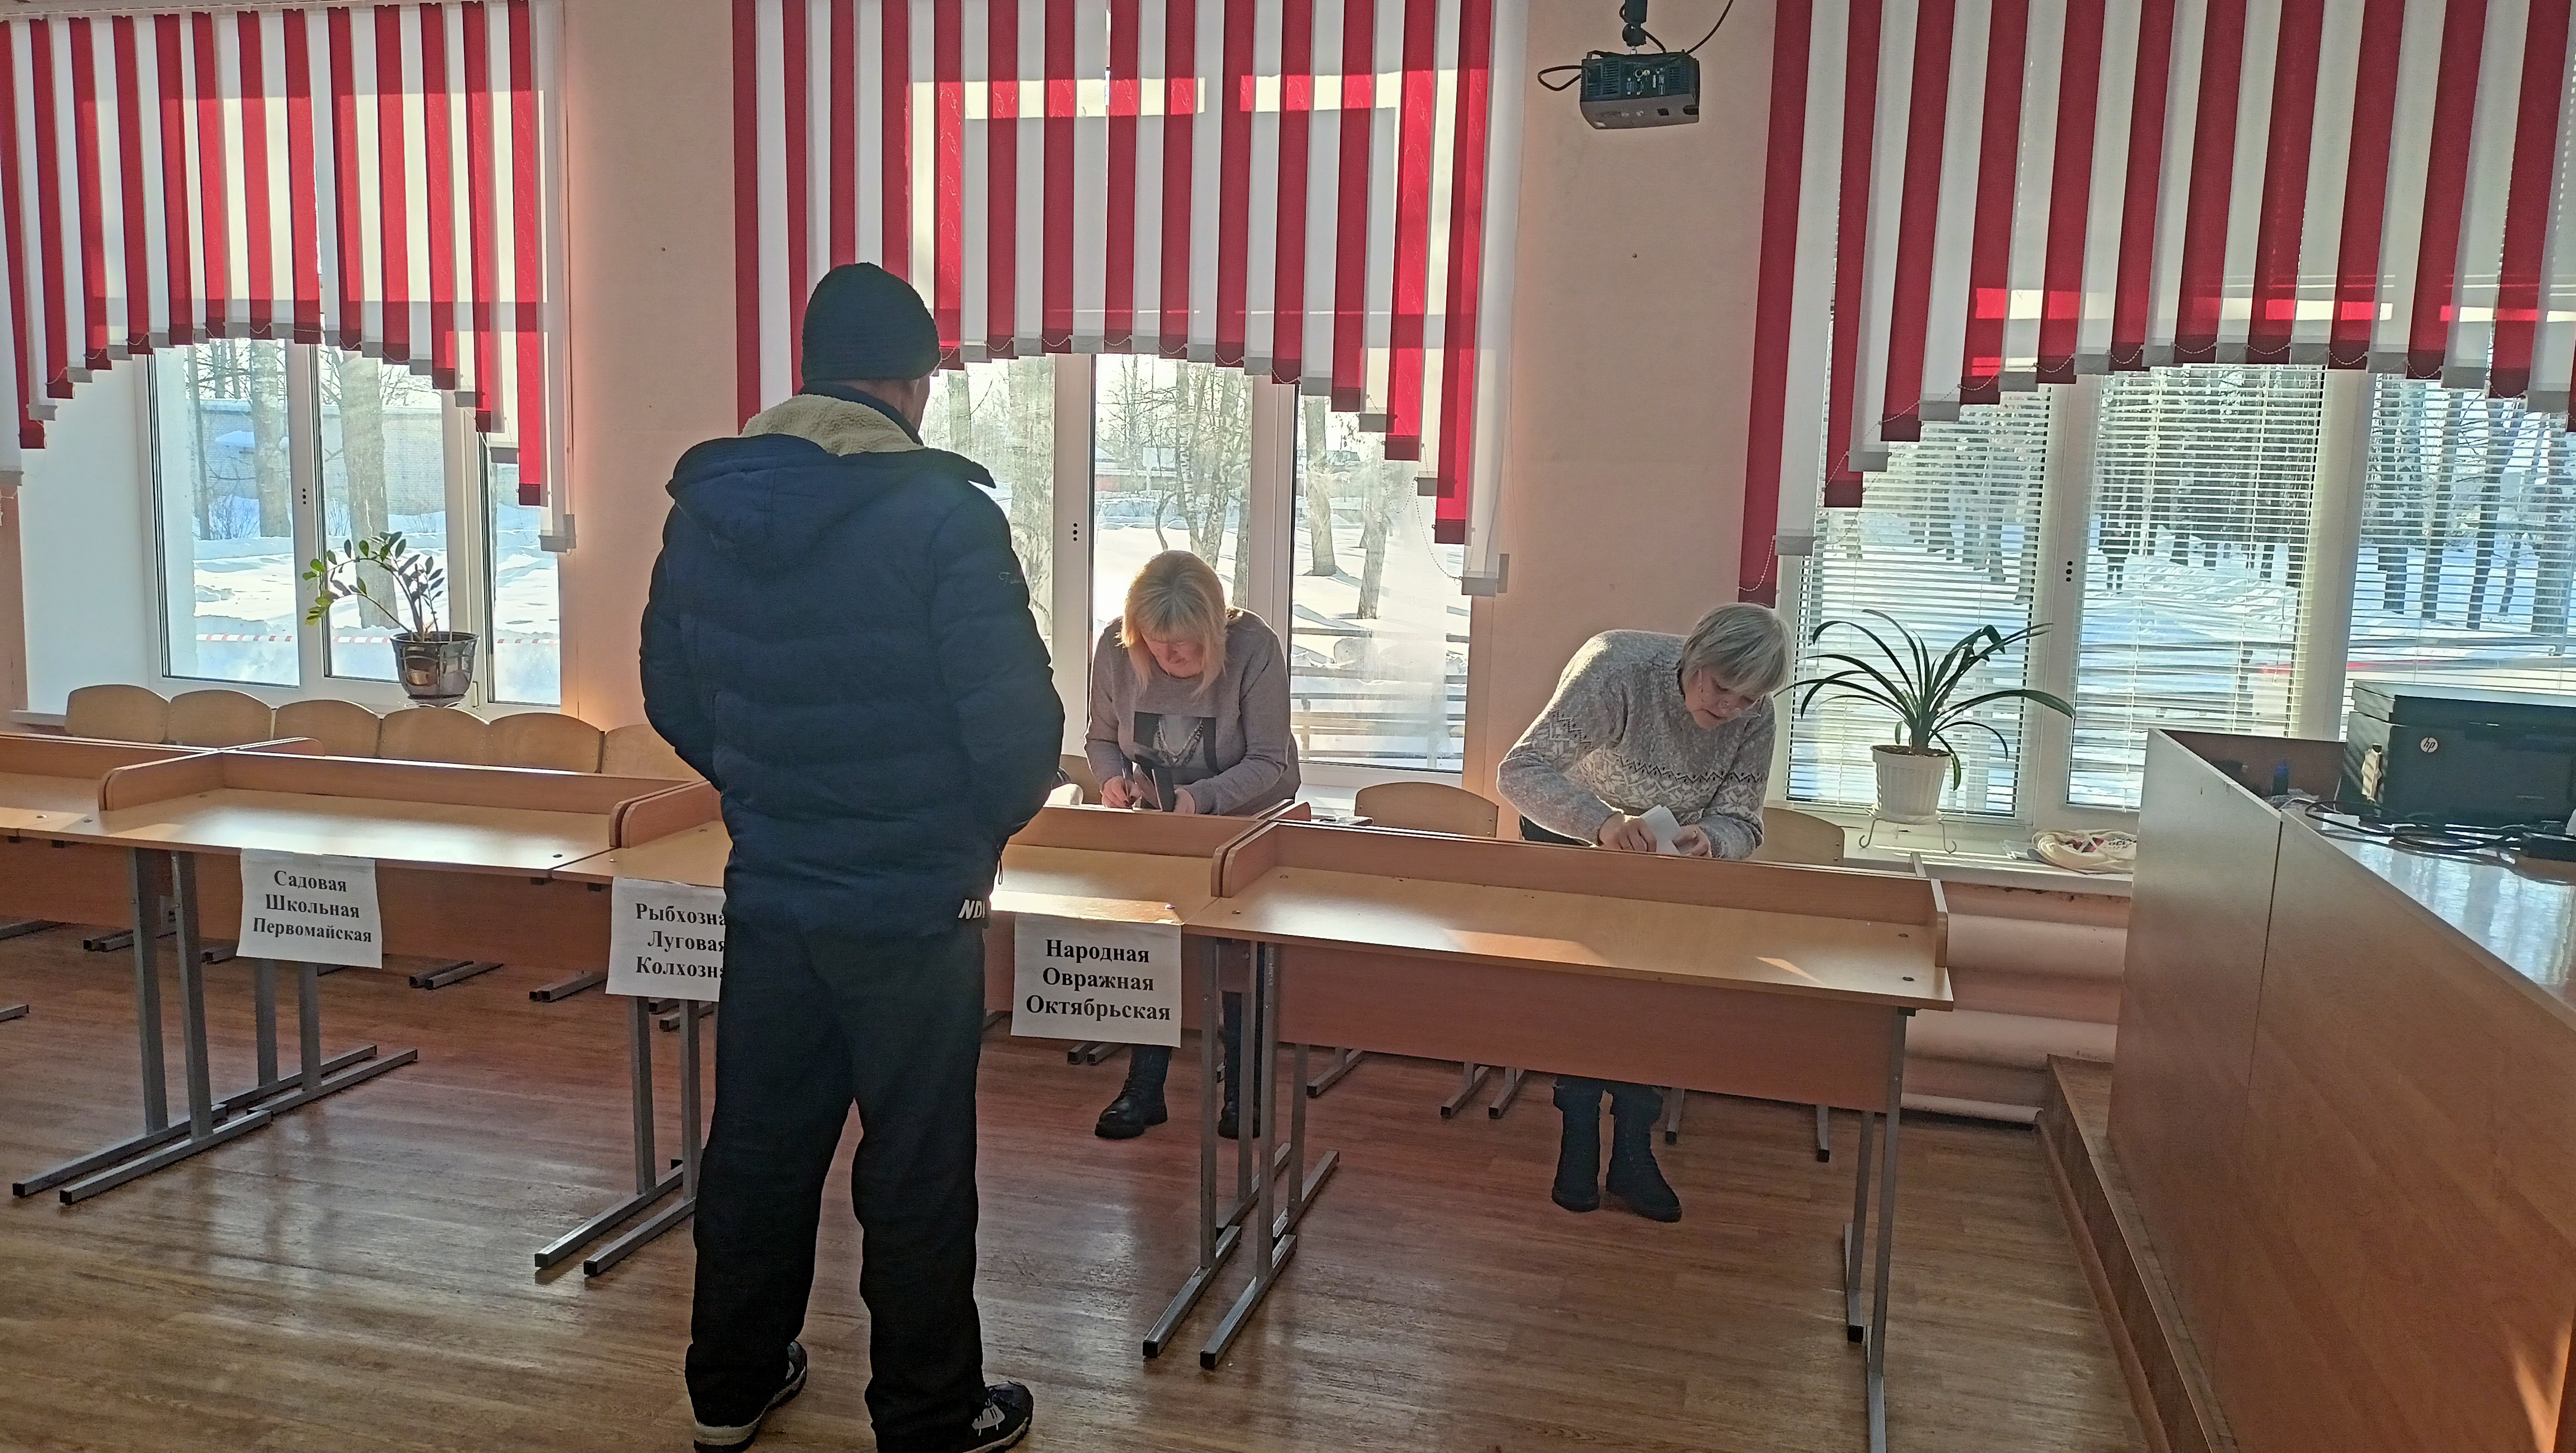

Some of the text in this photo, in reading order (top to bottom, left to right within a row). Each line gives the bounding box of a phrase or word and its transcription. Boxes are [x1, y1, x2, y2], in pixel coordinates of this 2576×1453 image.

[2422, 737, 2437, 752] hp
[274, 870, 347, 893] Садовая
[265, 894, 360, 918] Школьная
[253, 917, 372, 943] Первомайская
[1045, 939, 1150, 963] Народная
[1042, 967, 1154, 992] Овражная
[1026, 994, 1170, 1022] Октябрьская
